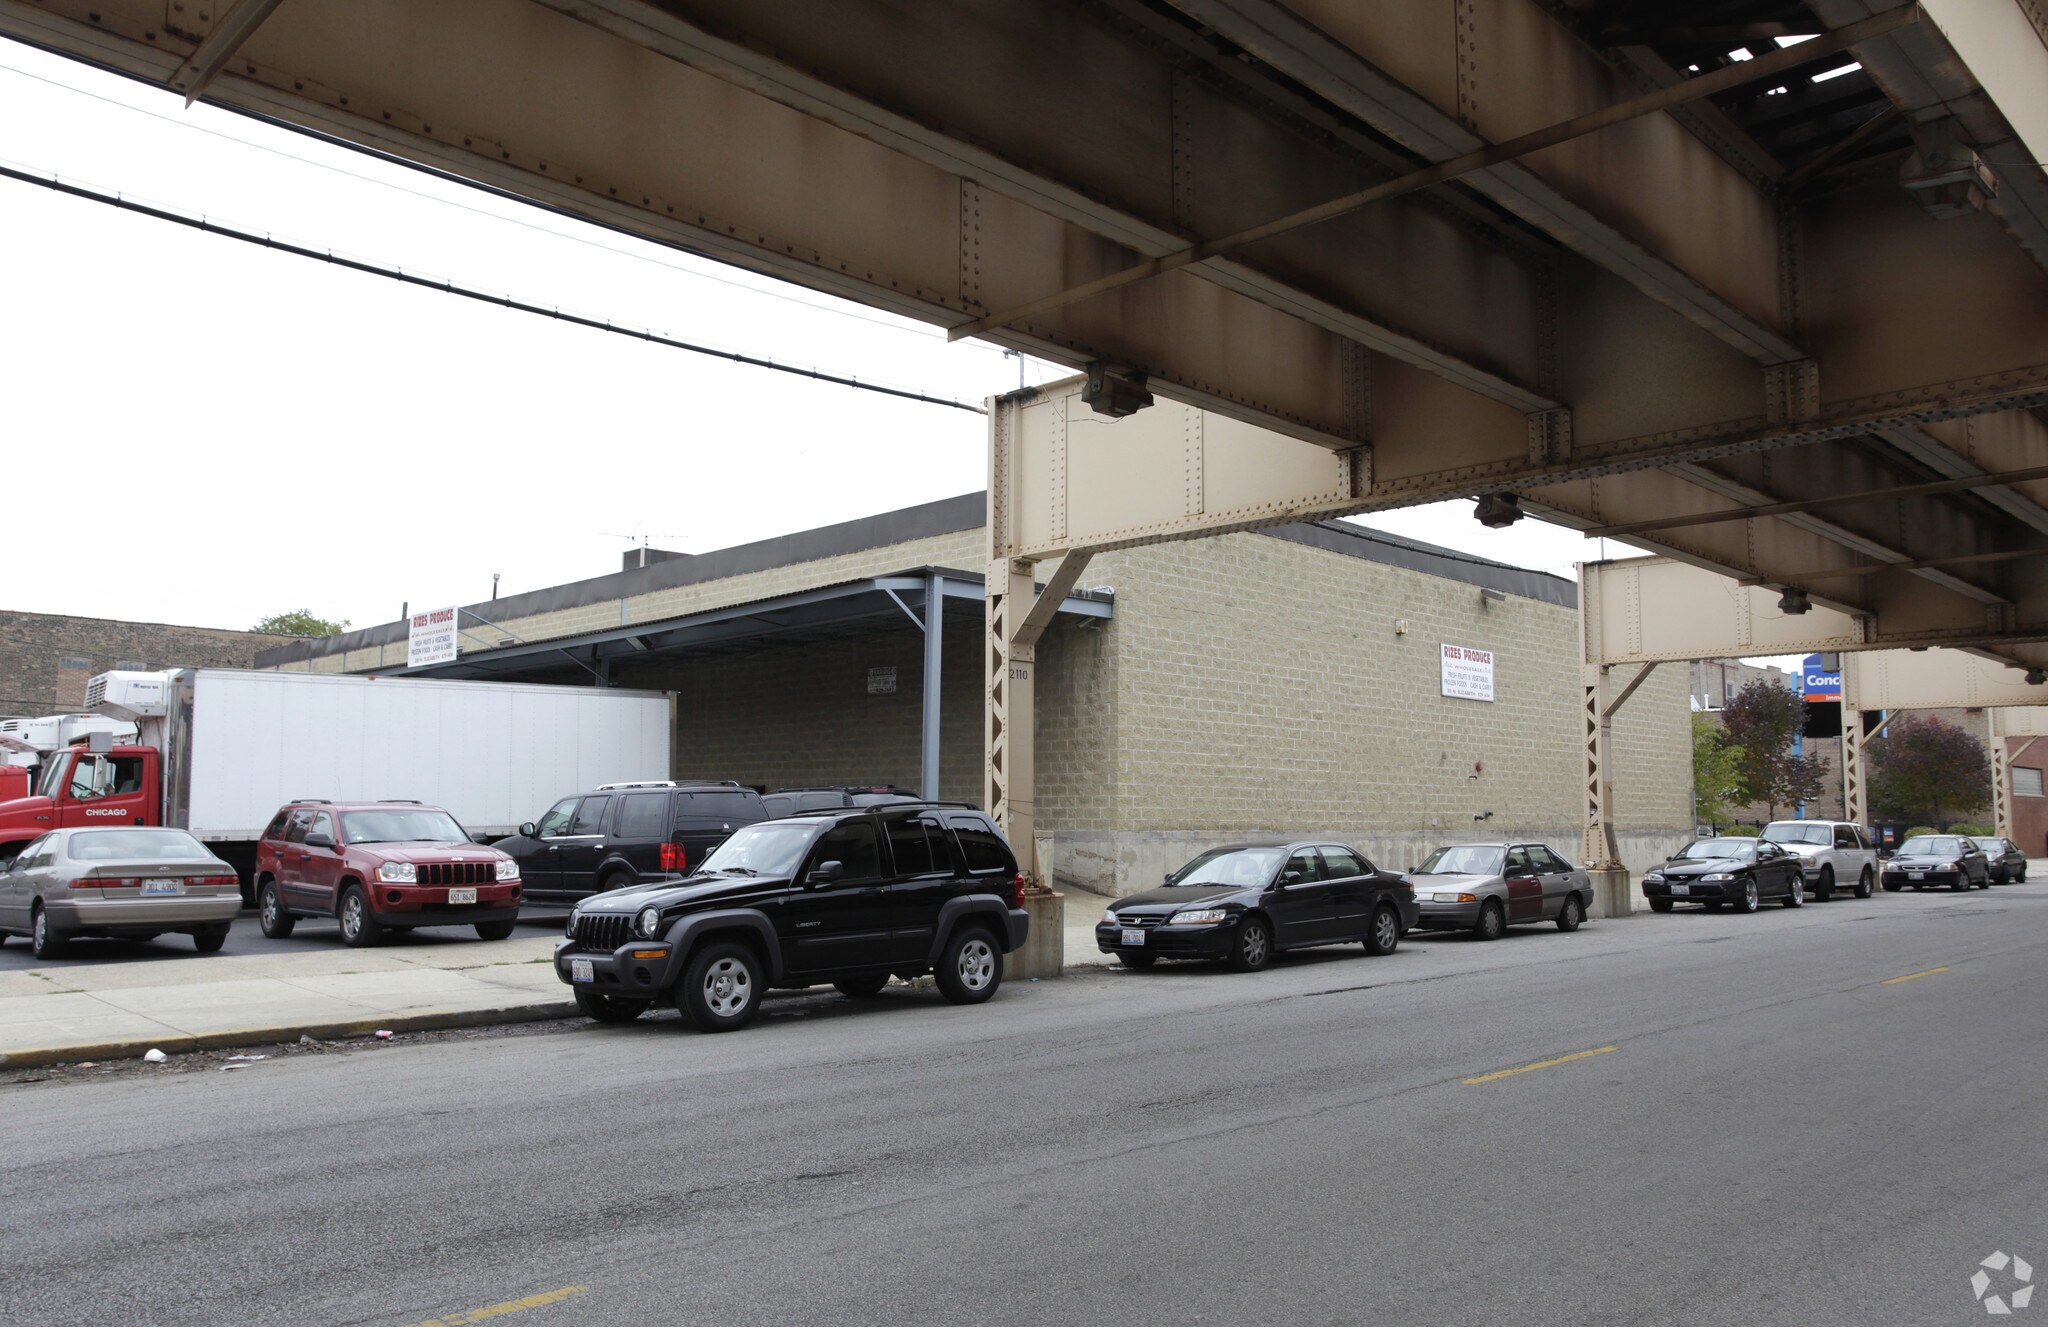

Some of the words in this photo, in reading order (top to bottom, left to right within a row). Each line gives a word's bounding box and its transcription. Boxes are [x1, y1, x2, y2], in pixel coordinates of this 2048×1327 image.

[414, 615, 428, 628] RIZES
[430, 609, 454, 624] PRODUCE
[1444, 646, 1462, 660] RIZES
[1464, 649, 1490, 664] PRODUCE
[1010, 669, 1028, 680] 2110
[86, 808, 127, 816] CHICAGO
